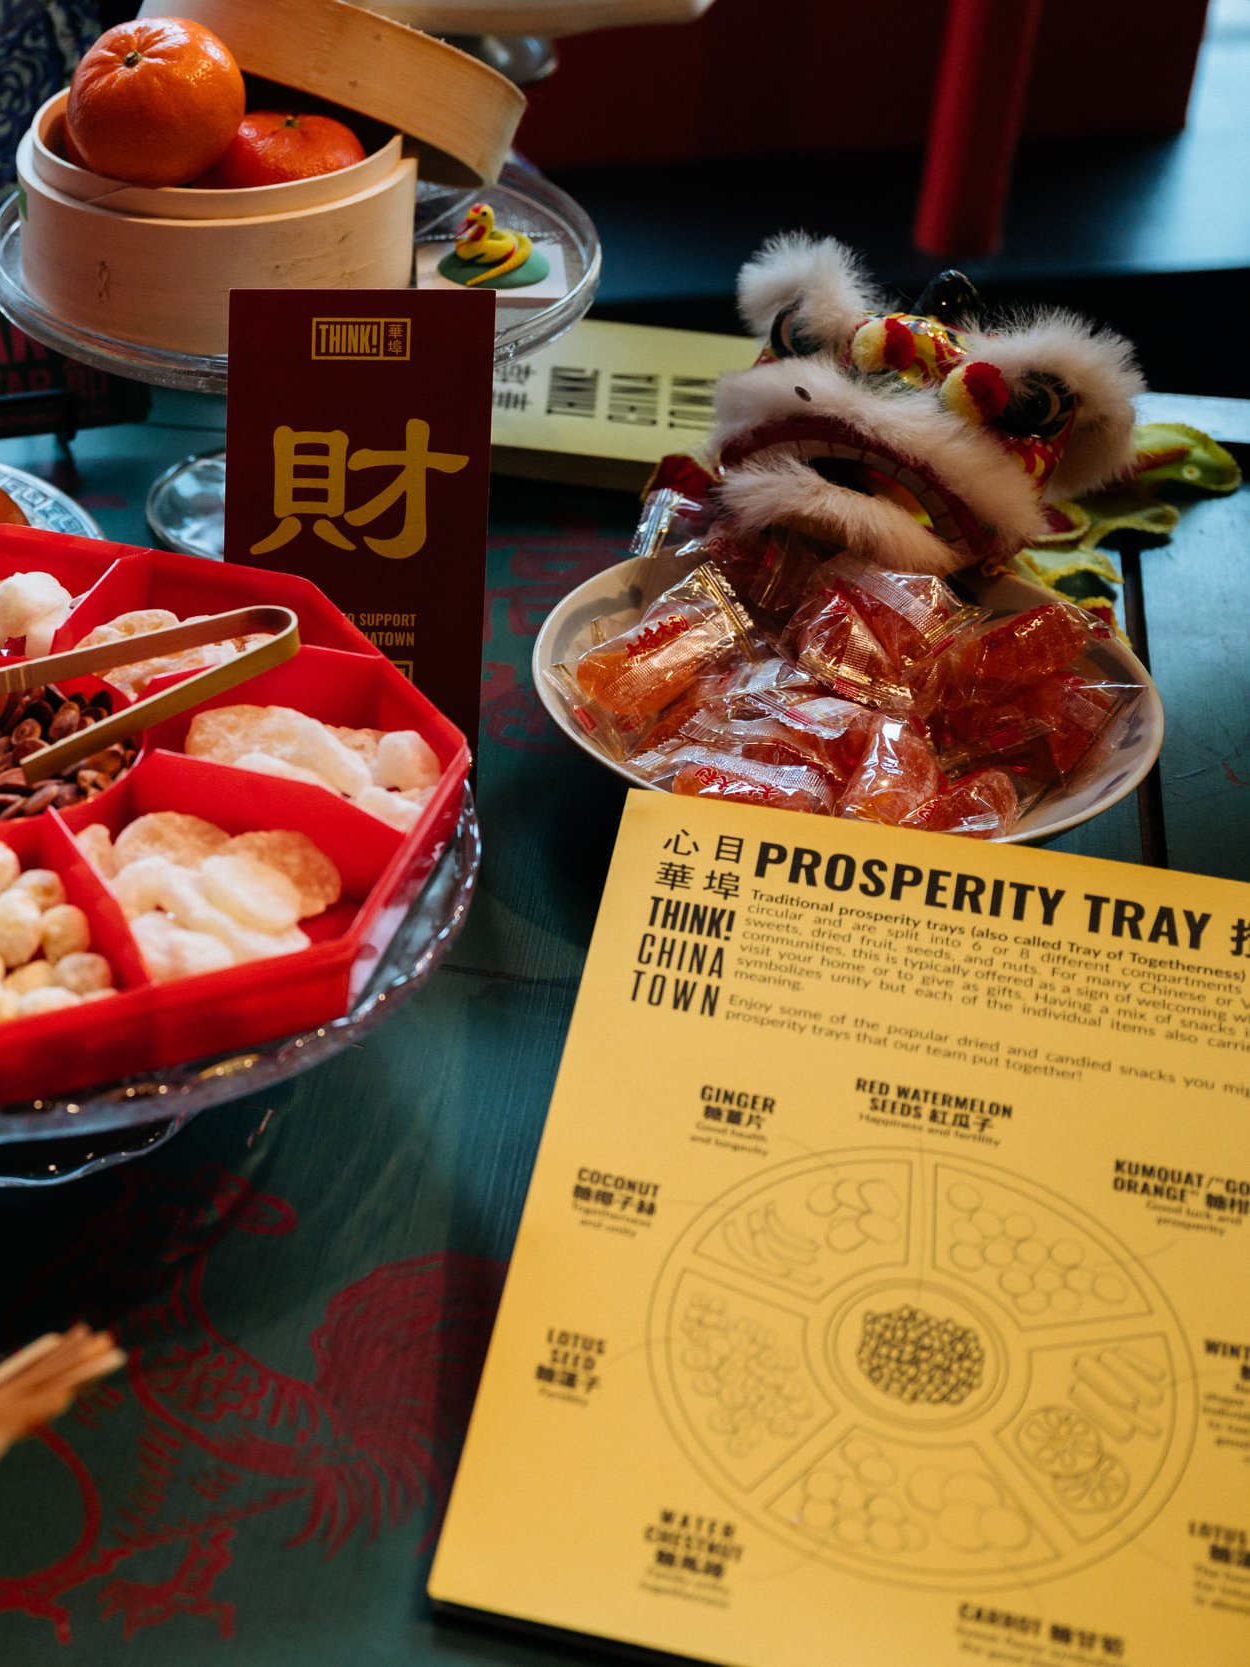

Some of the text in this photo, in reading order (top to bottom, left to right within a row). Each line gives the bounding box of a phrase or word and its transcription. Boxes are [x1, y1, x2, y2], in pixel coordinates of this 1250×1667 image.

[319, 325, 377, 353] THINK!
[250, 418, 469, 559] 財
[359, 613, 416, 627] SUPPORT
[663, 829, 744, 864] 心目
[655, 862, 740, 900] 華埠
[754, 841, 1065, 926] PROSPERITY
[1084, 894, 1212, 949] TRAY
[648, 895, 736, 941] THINK!
[751, 889, 1246, 982] Traditional prosperity trays (also called Tray of Togetherness)
[637, 933, 725, 979] CHINA
[744, 918, 803, 936] sweets,
[811, 928, 851, 944] dried
[861, 935, 895, 951] fruit,
[906, 943, 955, 961] seeds,
[964, 953, 994, 968] and
[1051, 967, 1077, 980] For
[1086, 974, 1131, 992] many
[1140, 981, 1207, 1002] Chinese
[1215, 995, 1233, 1006] or
[747, 903, 803, 921] circular
[813, 916, 842, 928] and
[852, 923, 877, 935] are
[887, 927, 919, 942] split
[930, 933, 961, 948] into
[972, 940, 982, 951] 6
[993, 945, 1009, 956] or
[1041, 952, 1109, 974] different
[1121, 967, 1242, 995] compartments
[631, 969, 720, 1017] TOWN
[737, 955, 822, 980] symbolizes
[831, 972, 872, 990] unity
[879, 979, 906, 995] but
[915, 987, 952, 1003] each
[961, 995, 979, 1007] of
[987, 998, 1013, 1012] the
[1022, 1004, 1102, 1028] individual
[1110, 1018, 1156, 1037] items
[1165, 1028, 1198, 1045] also
[739, 943, 771, 958] visit
[778, 950, 814, 966] your
[820, 954, 866, 973] home
[873, 966, 889, 978] or
[898, 970, 914, 981] to
[922, 975, 955, 991] give
[962, 982, 979, 993] as
[1035, 992, 1092, 1013] Having
[1100, 1005, 1109, 1015] a
[1118, 1008, 1147, 1021] mix
[1155, 1013, 1172, 1025] of
[1180, 1017, 1236, 1038] snacks
[742, 930, 846, 958] communities,
[852, 947, 880, 962] this
[886, 953, 898, 965] is
[904, 956, 970, 978] typically
[975, 967, 1033, 988] offered
[1039, 980, 1056, 992] as
[1062, 984, 1071, 995] a
[1077, 986, 1109, 1005] sign
[1115, 992, 1132, 1004] of
[1138, 996, 1227, 1023] welcoming
[725, 1010, 807, 1035] prosperity
[812, 1024, 851, 1042] trays
[856, 1033, 888, 1049] that
[893, 1040, 920, 1054] our
[926, 1045, 968, 1063] team
[972, 1053, 1000, 1068] put
[729, 994, 773, 1013] Enjoy
[779, 1003, 822, 1021] some
[830, 1013, 846, 1024] of
[854, 1017, 880, 1032] the
[888, 1024, 949, 1044] popular
[958, 1036, 1000, 1054] dried
[1008, 1042, 1039, 1059] and
[1045, 1050, 1112, 1074] candied
[1120, 1063, 1177, 1084] snacks
[1182, 1077, 1215, 1092] you
[701, 1085, 776, 1114] GINGER
[855, 1077, 1013, 1119] RED WATERMELON
[870, 1097, 922, 1119] SEEDS
[577, 1167, 660, 1198] COCONUT
